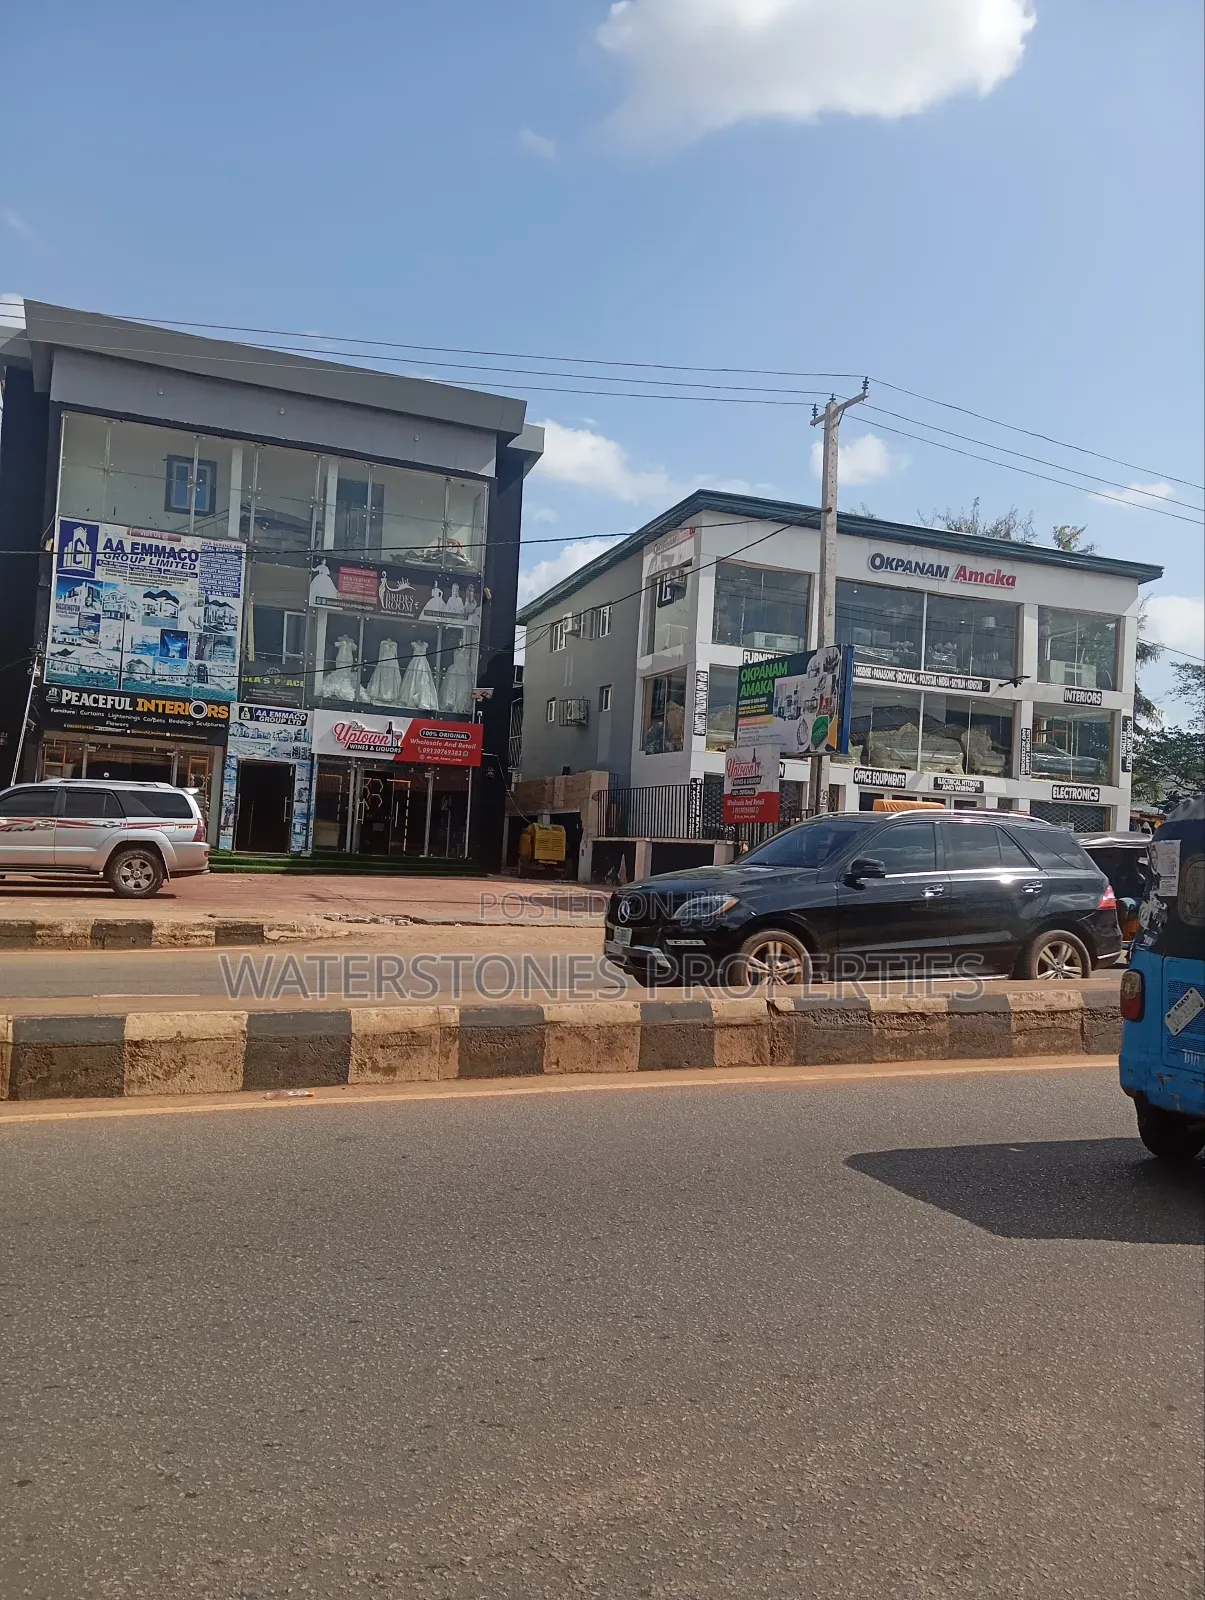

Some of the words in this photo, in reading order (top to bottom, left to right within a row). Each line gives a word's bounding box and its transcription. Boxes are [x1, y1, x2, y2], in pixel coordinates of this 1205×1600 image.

[103, 538, 125, 553] AA
[131, 541, 199, 562] EMMACO
[103, 553, 146, 564] GROUP
[149, 559, 196, 571] LIMITED
[870, 552, 949, 579] OKPANAM
[955, 565, 1017, 587] Amaka
[741, 661, 788, 682] OKPANAM
[740, 680, 773, 697] AMAKA
[1065, 690, 1102, 704] INTERIORS
[61, 689, 133, 711] PEACEFUL
[136, 698, 229, 719] INTERIORS
[108, 712, 140, 721] Lightenings
[143, 716, 166, 724] Carpets
[168, 718, 194, 726] Beddings
[196, 720, 226, 728] Sculptures
[259, 716, 286, 724] GROUP
[269, 711, 306, 720] EMMACO
[334, 723, 390, 748] Uptown
[854, 770, 872, 783] OFFICE
[872, 771, 905, 786] EQUIPMENTS
[1052, 787, 1099, 801] ELECTRONICS
